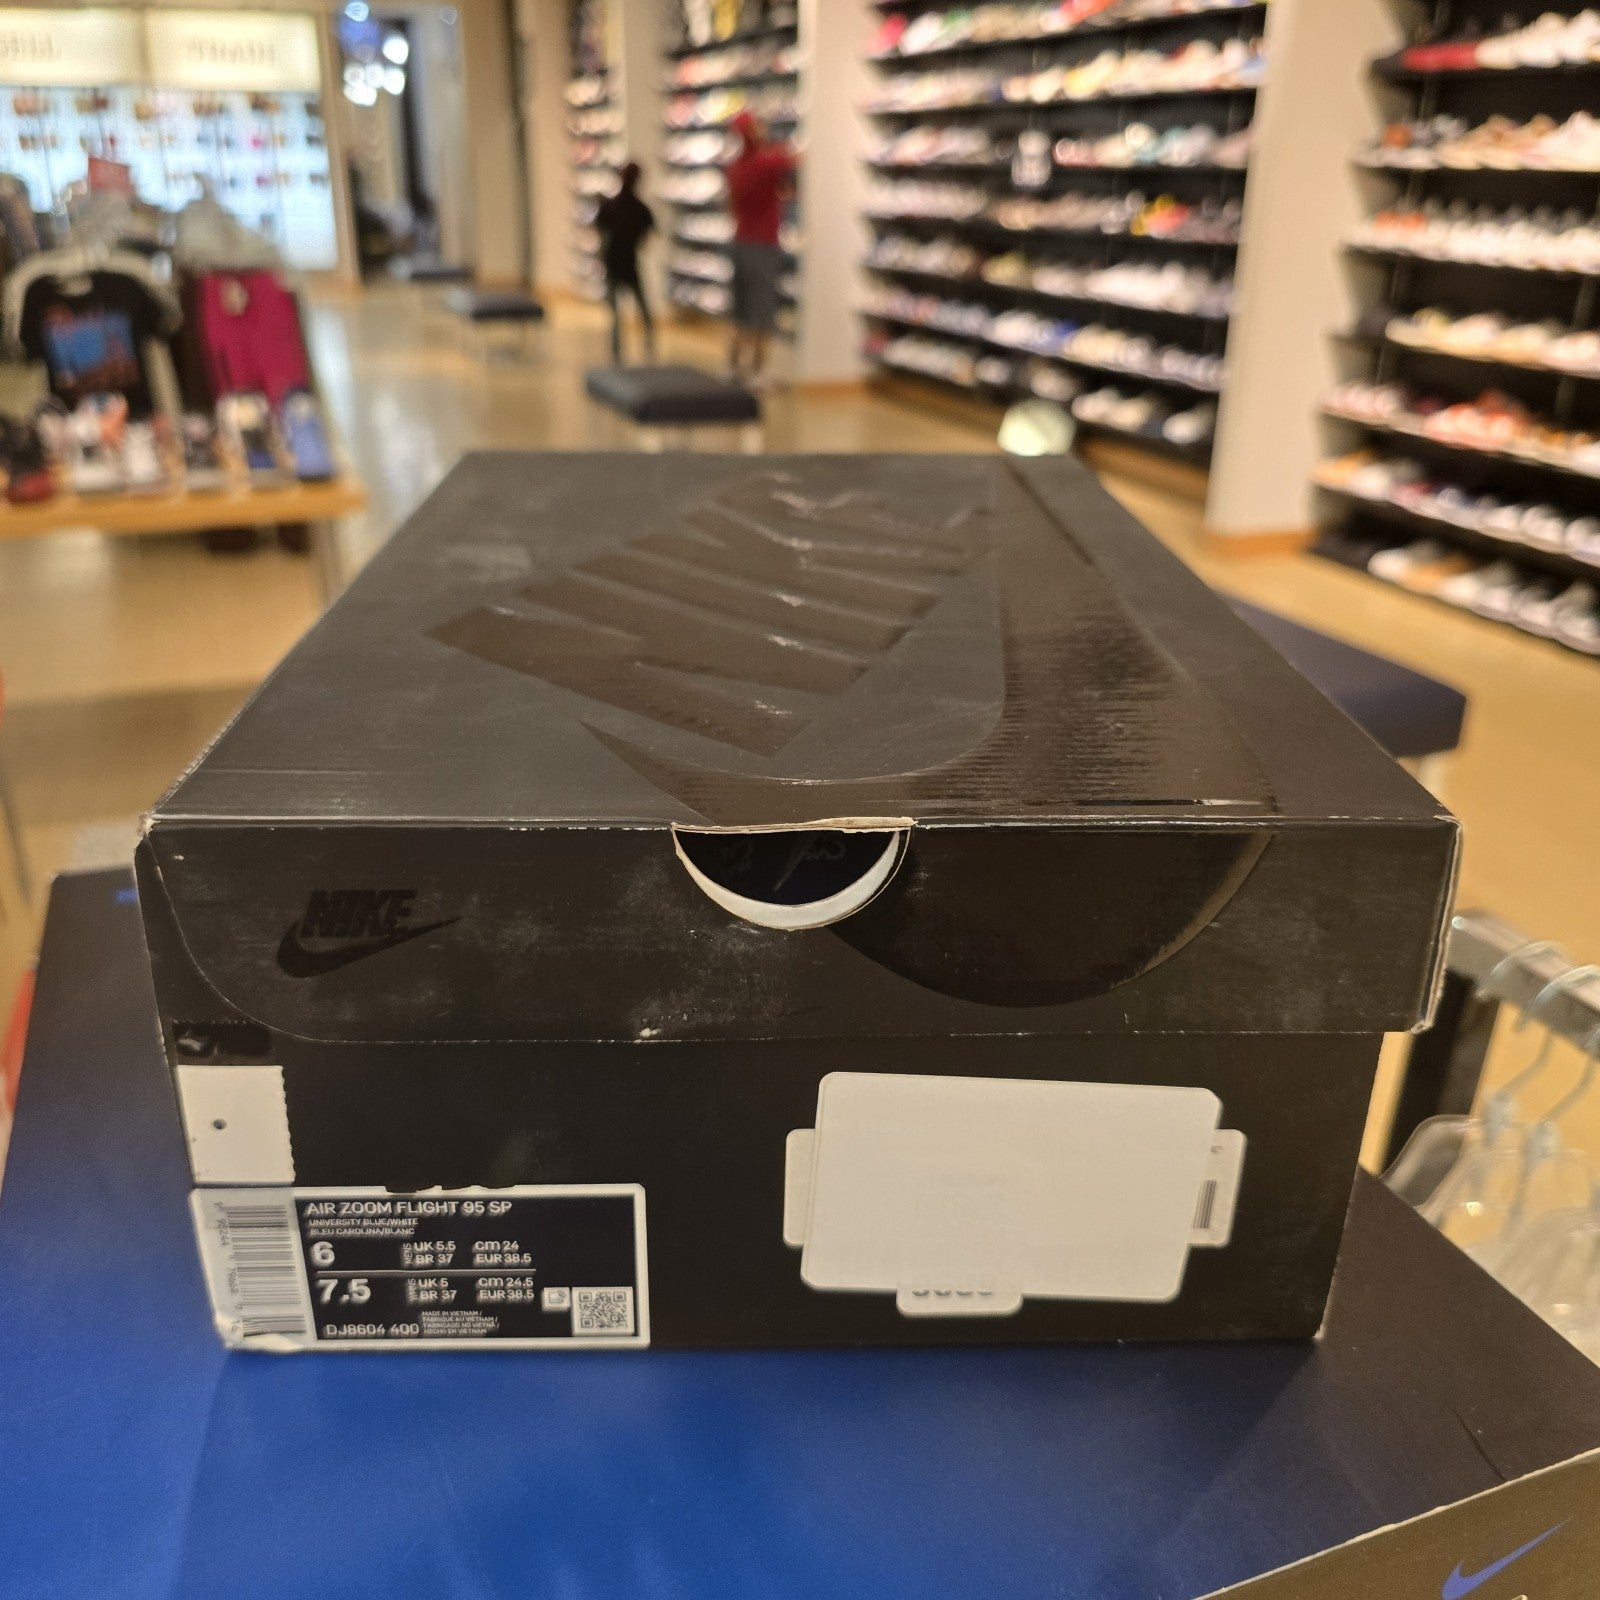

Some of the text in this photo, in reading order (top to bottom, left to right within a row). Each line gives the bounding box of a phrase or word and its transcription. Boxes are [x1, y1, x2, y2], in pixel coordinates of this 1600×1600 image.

[300, 888, 417, 938] NIKE
[306, 1201, 513, 1215] AIR ZOOM FLIGHT 95 SP
[308, 1217, 420, 1227] UNIVERSITY BLUE/WHITE
[310, 1227, 416, 1236] BLEU CAROLINA/BLANC
[413, 1240, 457, 1252] UK 5.5
[502, 1240, 520, 1251] 24
[312, 1241, 336, 1265] 6
[415, 1253, 454, 1264] BR 37
[475, 1252, 532, 1264] EUR 38.5
[418, 1277, 449, 1289] UK 5
[505, 1277, 534, 1288] 24.5
[318, 1278, 372, 1302] 7.5
[419, 1289, 458, 1300] BR 37
[478, 1289, 535, 1300] EUR 38.5
[325, 1323, 420, 1336] DJ8604 400
